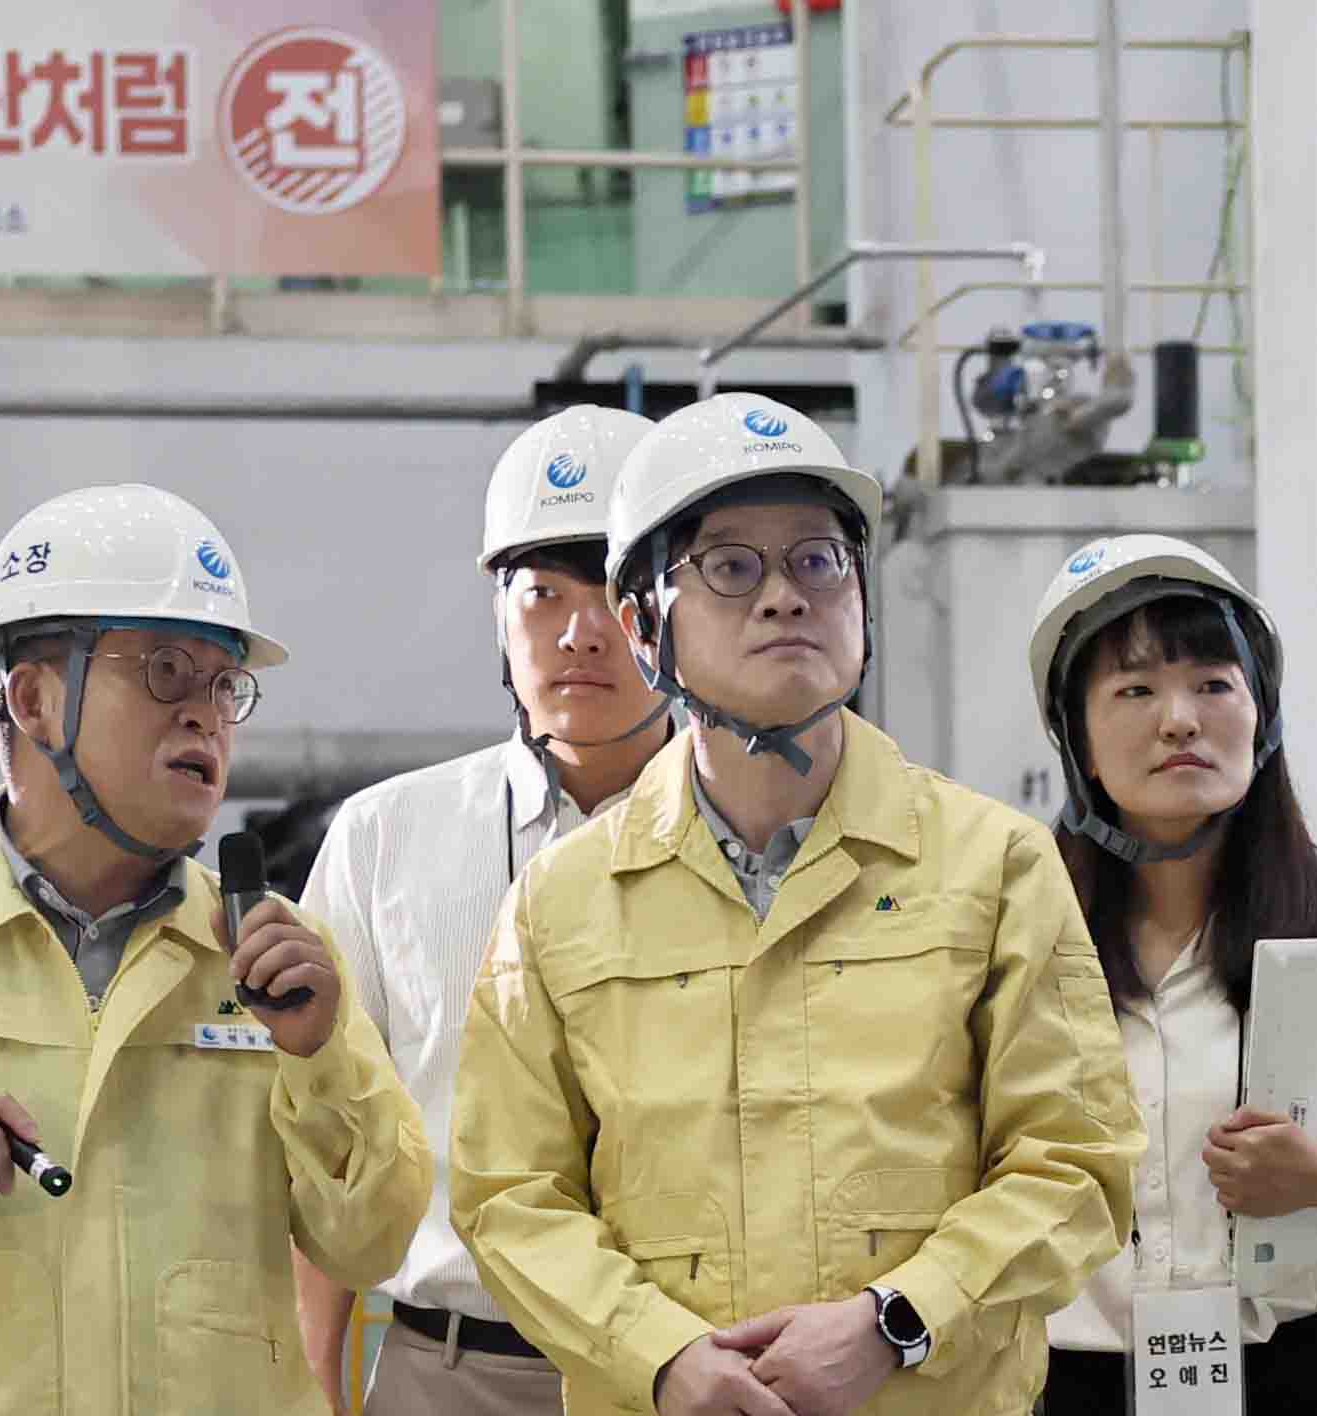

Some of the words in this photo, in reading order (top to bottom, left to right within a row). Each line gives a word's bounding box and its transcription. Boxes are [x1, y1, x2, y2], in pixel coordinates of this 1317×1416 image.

[265, 67, 365, 171] 전
[743, 441, 803, 455] KOMIPO
[539, 491, 595, 508] KOMIPO
[0, 541, 52, 582] 소장
[1147, 1330, 1228, 1356] 연합뉴스
